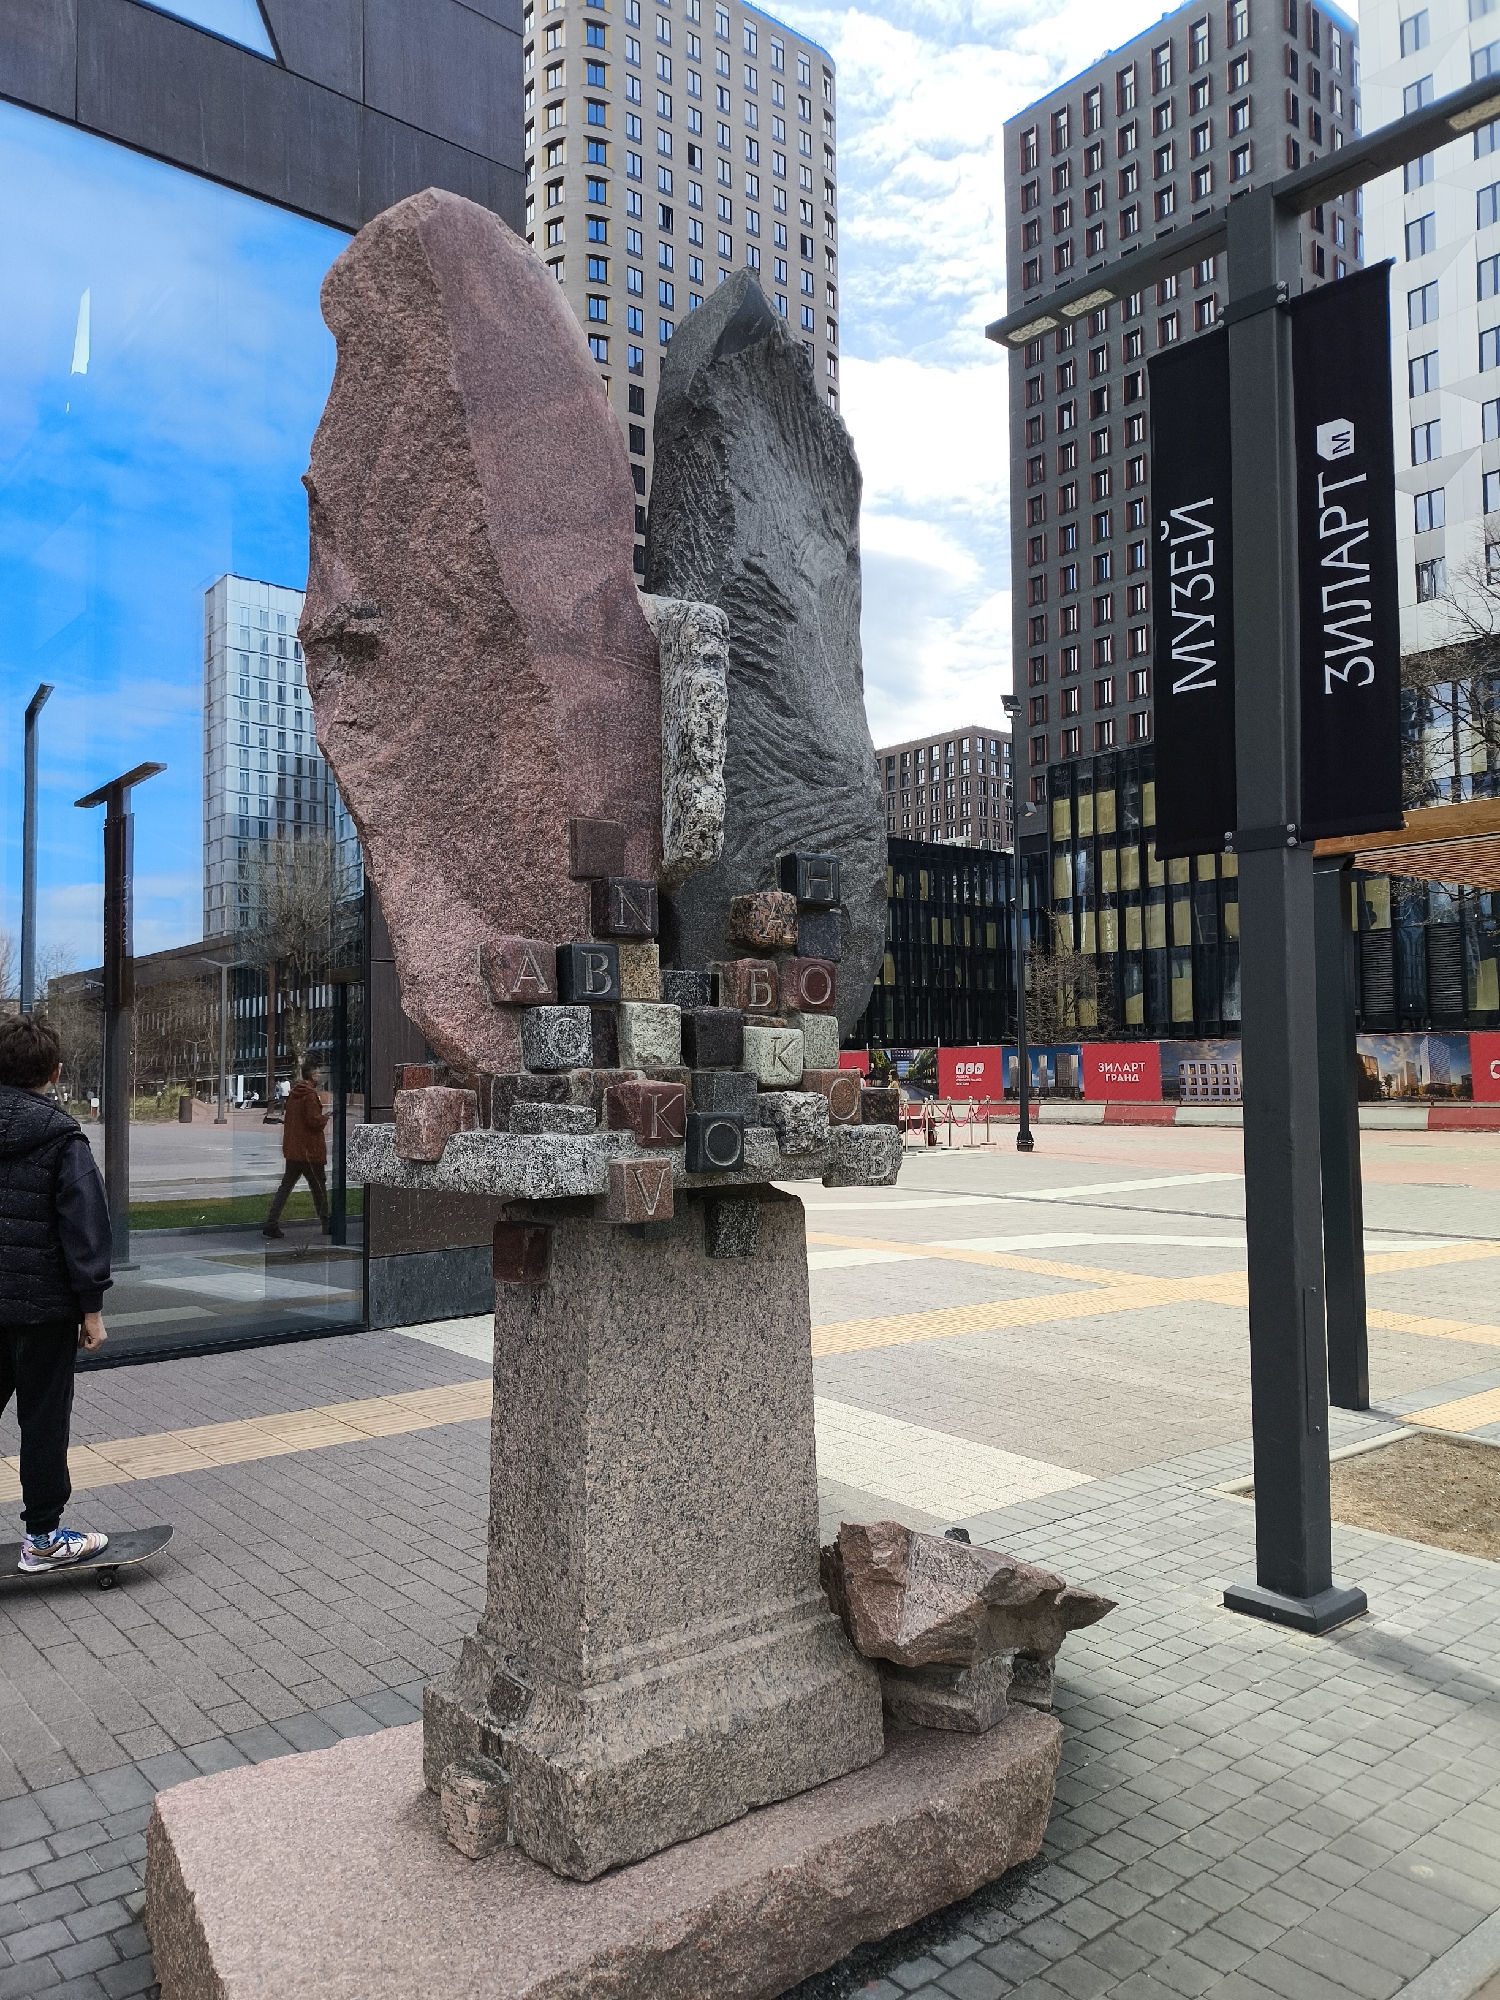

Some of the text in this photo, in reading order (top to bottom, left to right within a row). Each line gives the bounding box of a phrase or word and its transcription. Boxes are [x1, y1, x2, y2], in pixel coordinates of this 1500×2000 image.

[1160, 497, 1217, 695] МУЗЕЙ
[1317, 471, 1374, 695] ЗИЛАРТ
[615, 884, 655, 932] N
[746, 968, 772, 1007] Б
[1098, 1062, 1146, 1073] ЗИЛАРТ
[1105, 1073, 1140, 1082] ГРАНД
[629, 1167, 670, 1216] V
